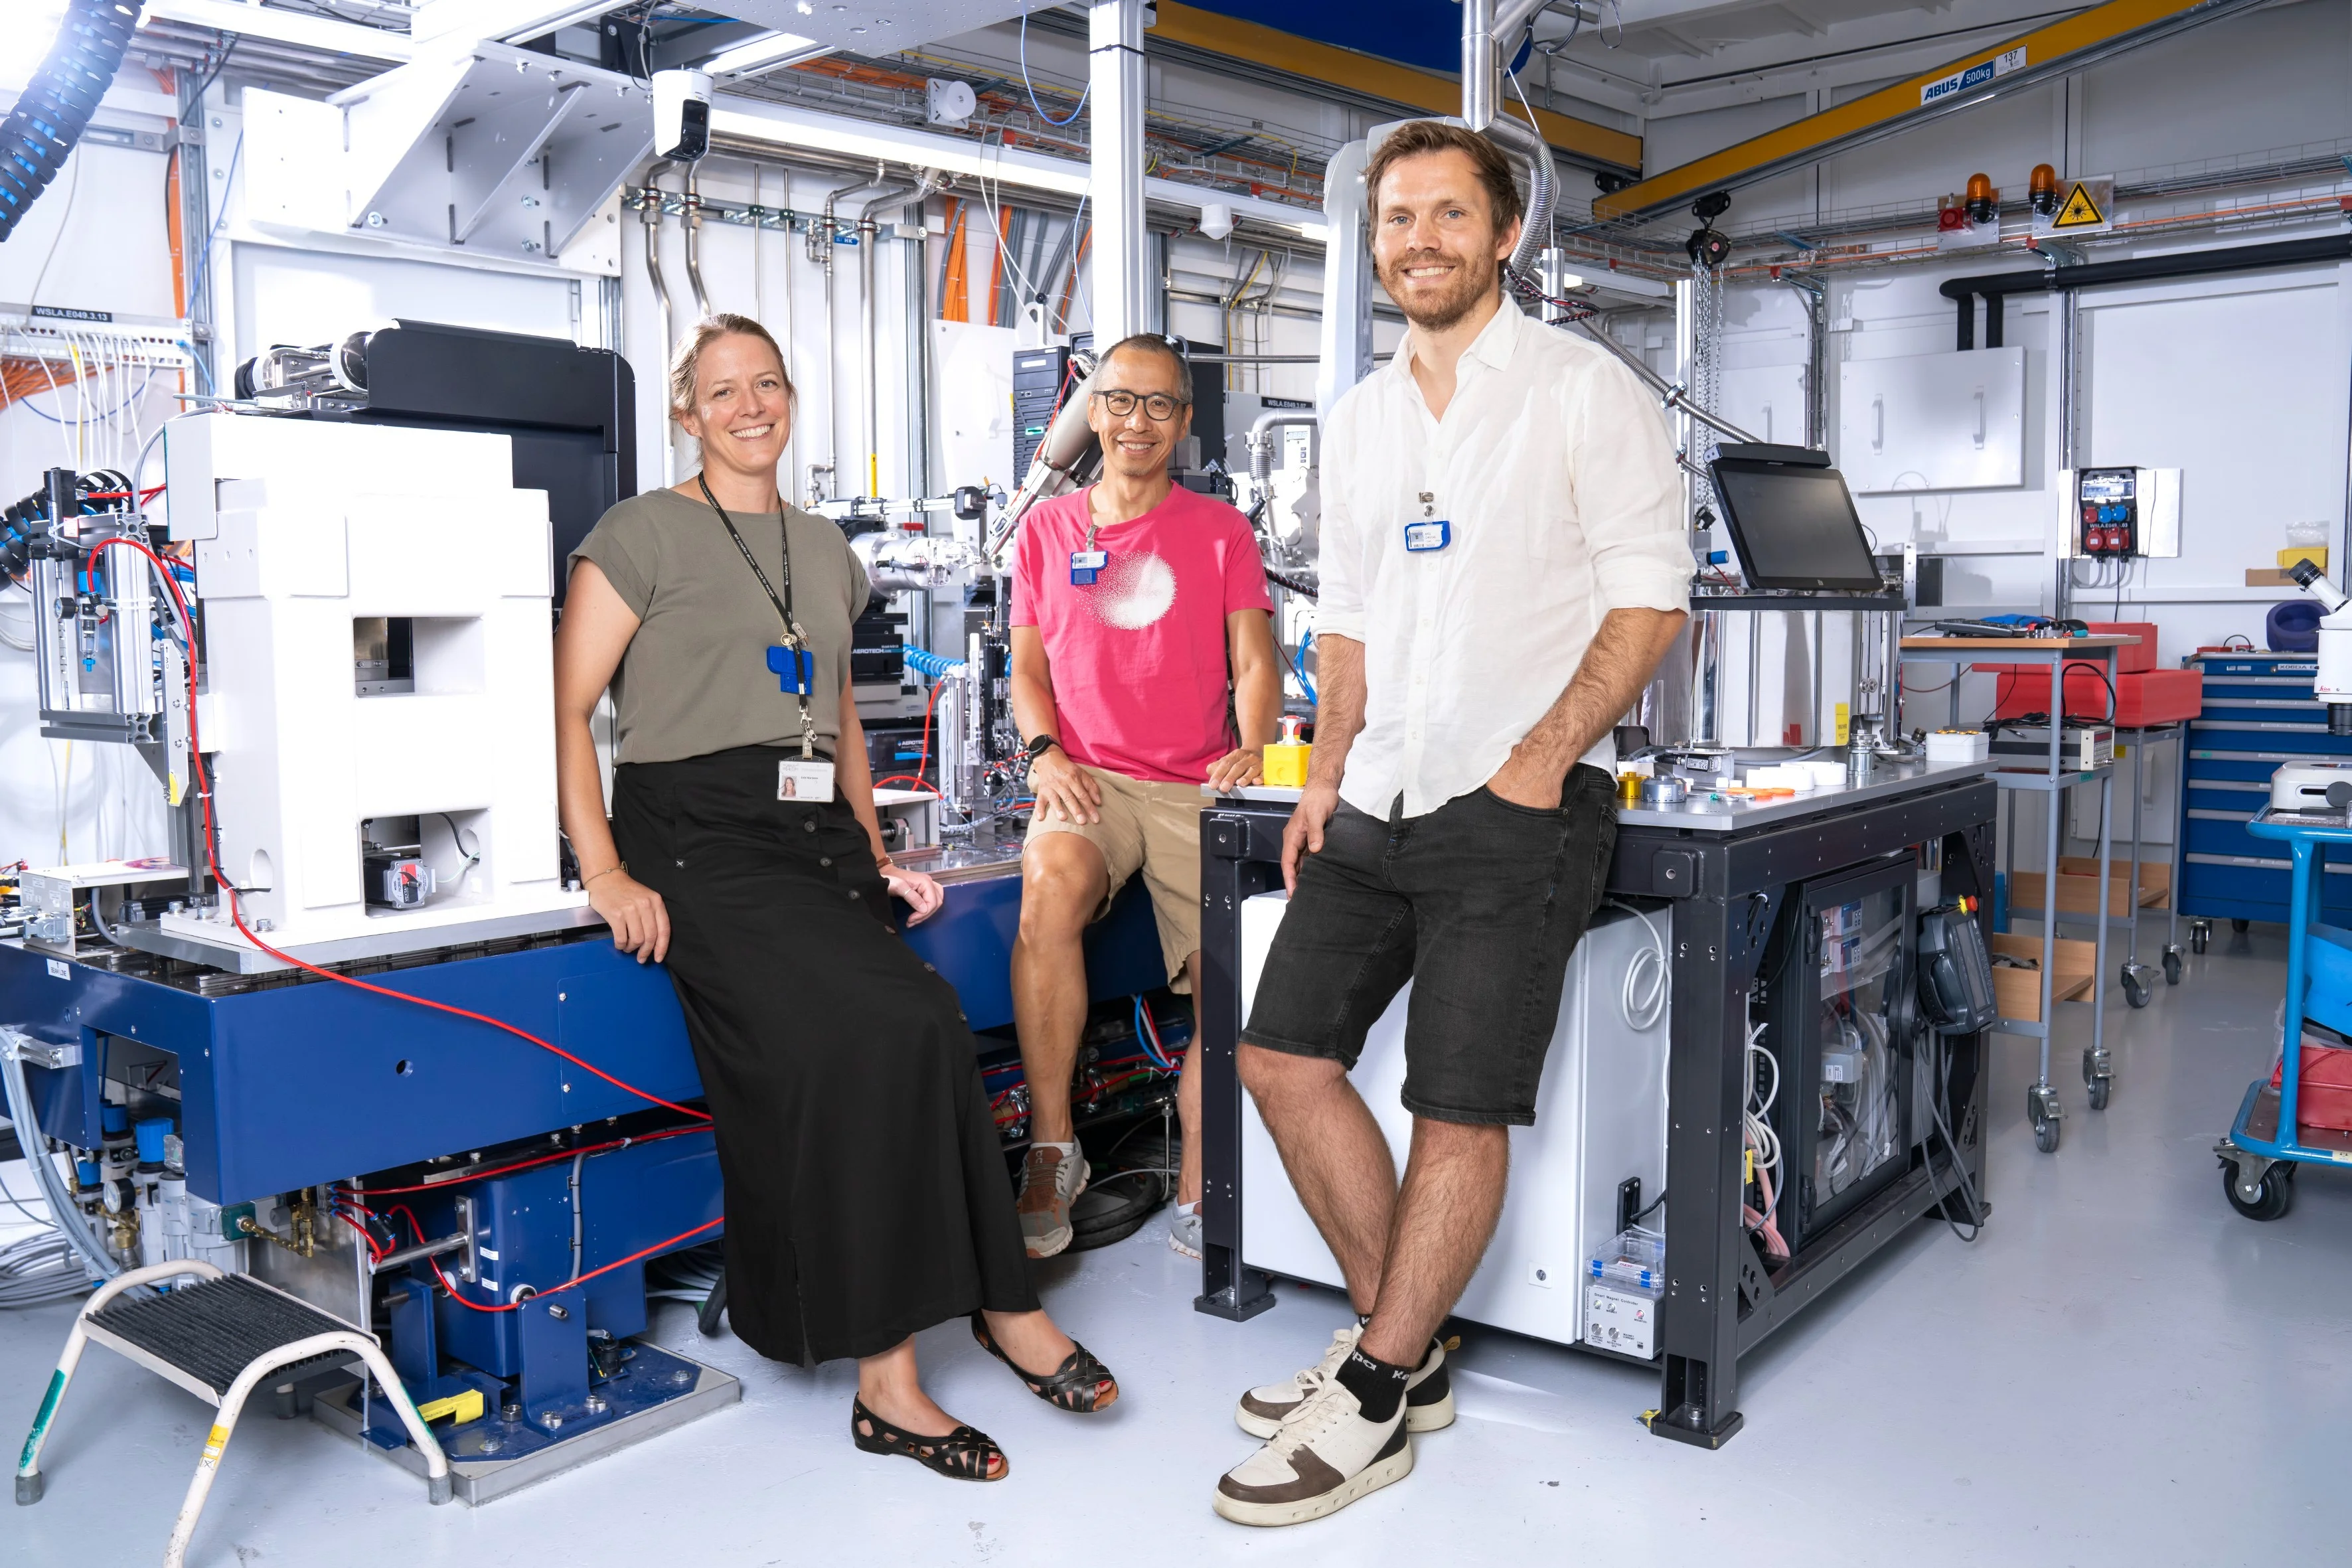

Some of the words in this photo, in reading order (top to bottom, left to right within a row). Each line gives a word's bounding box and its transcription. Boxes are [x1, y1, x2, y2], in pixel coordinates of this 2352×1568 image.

[2003, 50, 2018, 63] 137
[1924, 78, 1958, 101] ABUS
[1966, 68, 1991, 84] 500kg
[35, 307, 108, 321] WSLA.E049.3.13
